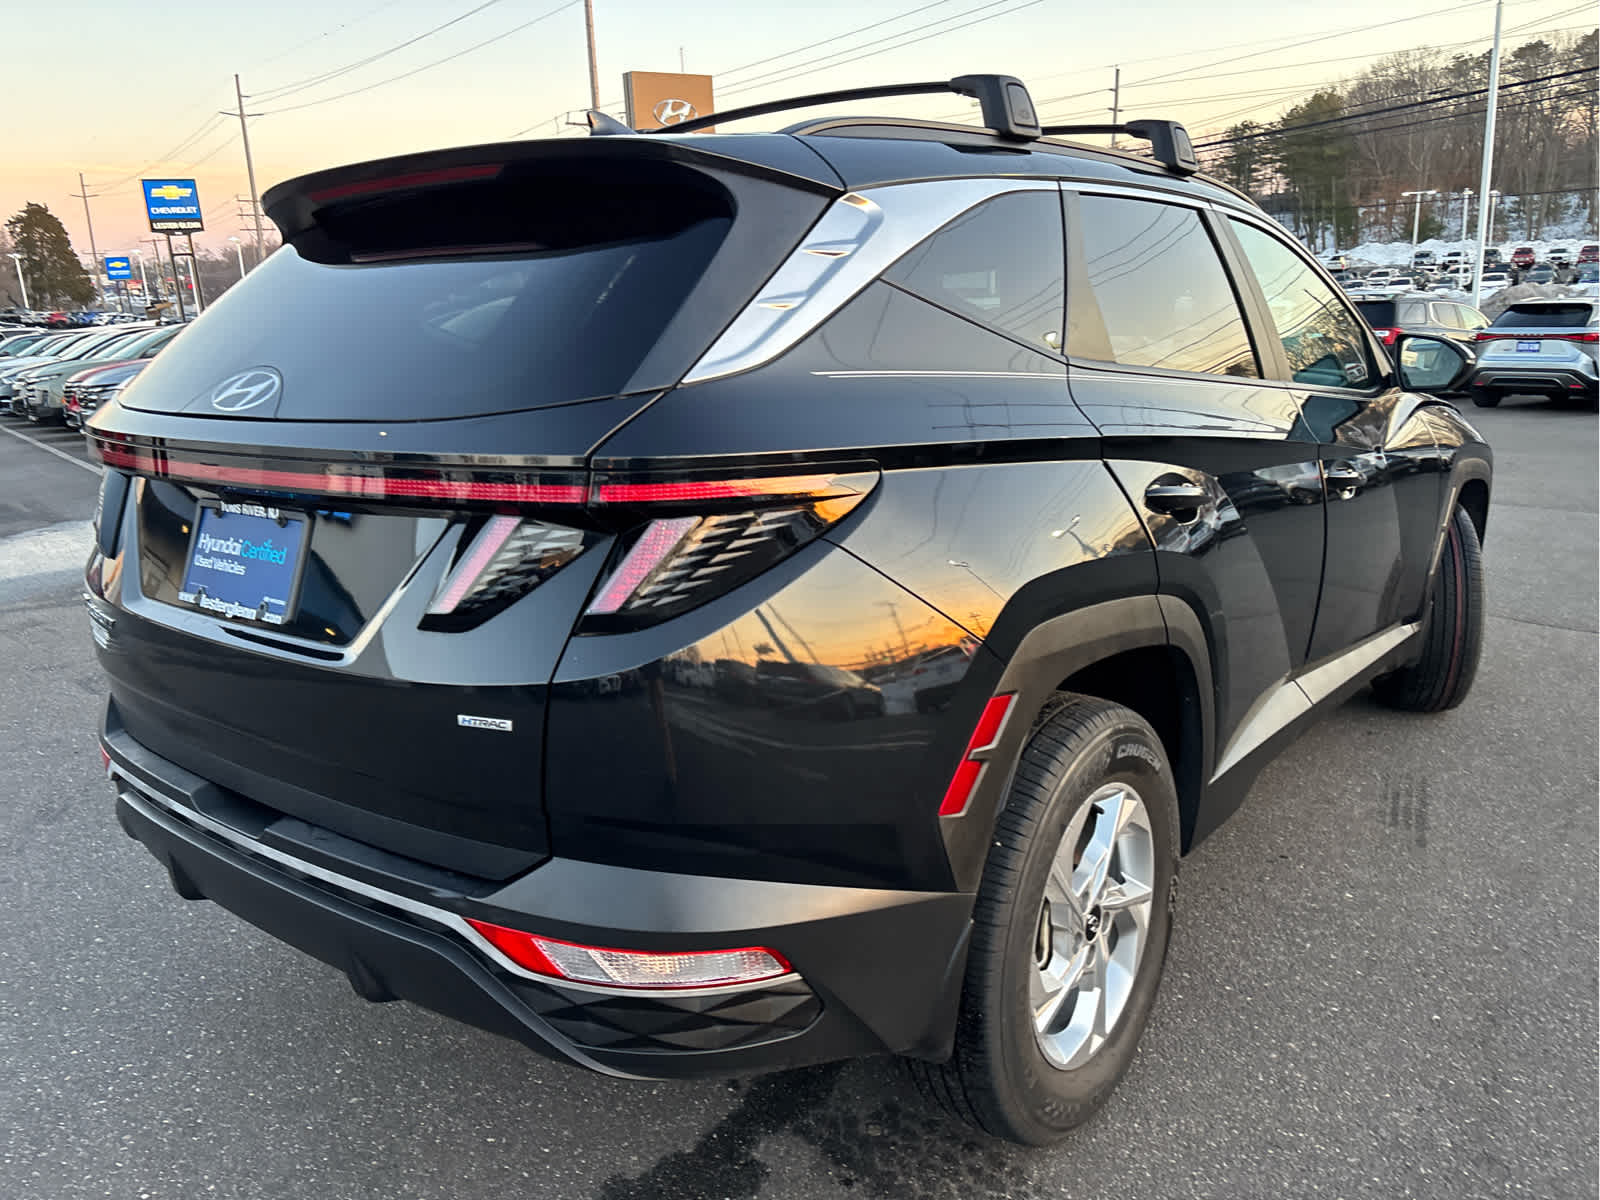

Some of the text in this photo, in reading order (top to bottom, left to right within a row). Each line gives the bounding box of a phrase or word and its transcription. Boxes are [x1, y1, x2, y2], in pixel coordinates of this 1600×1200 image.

[151, 206, 197, 214] CHEVROLET
[194, 554, 247, 575] Used Vehicles
[462, 717, 507, 728] HTRAC
